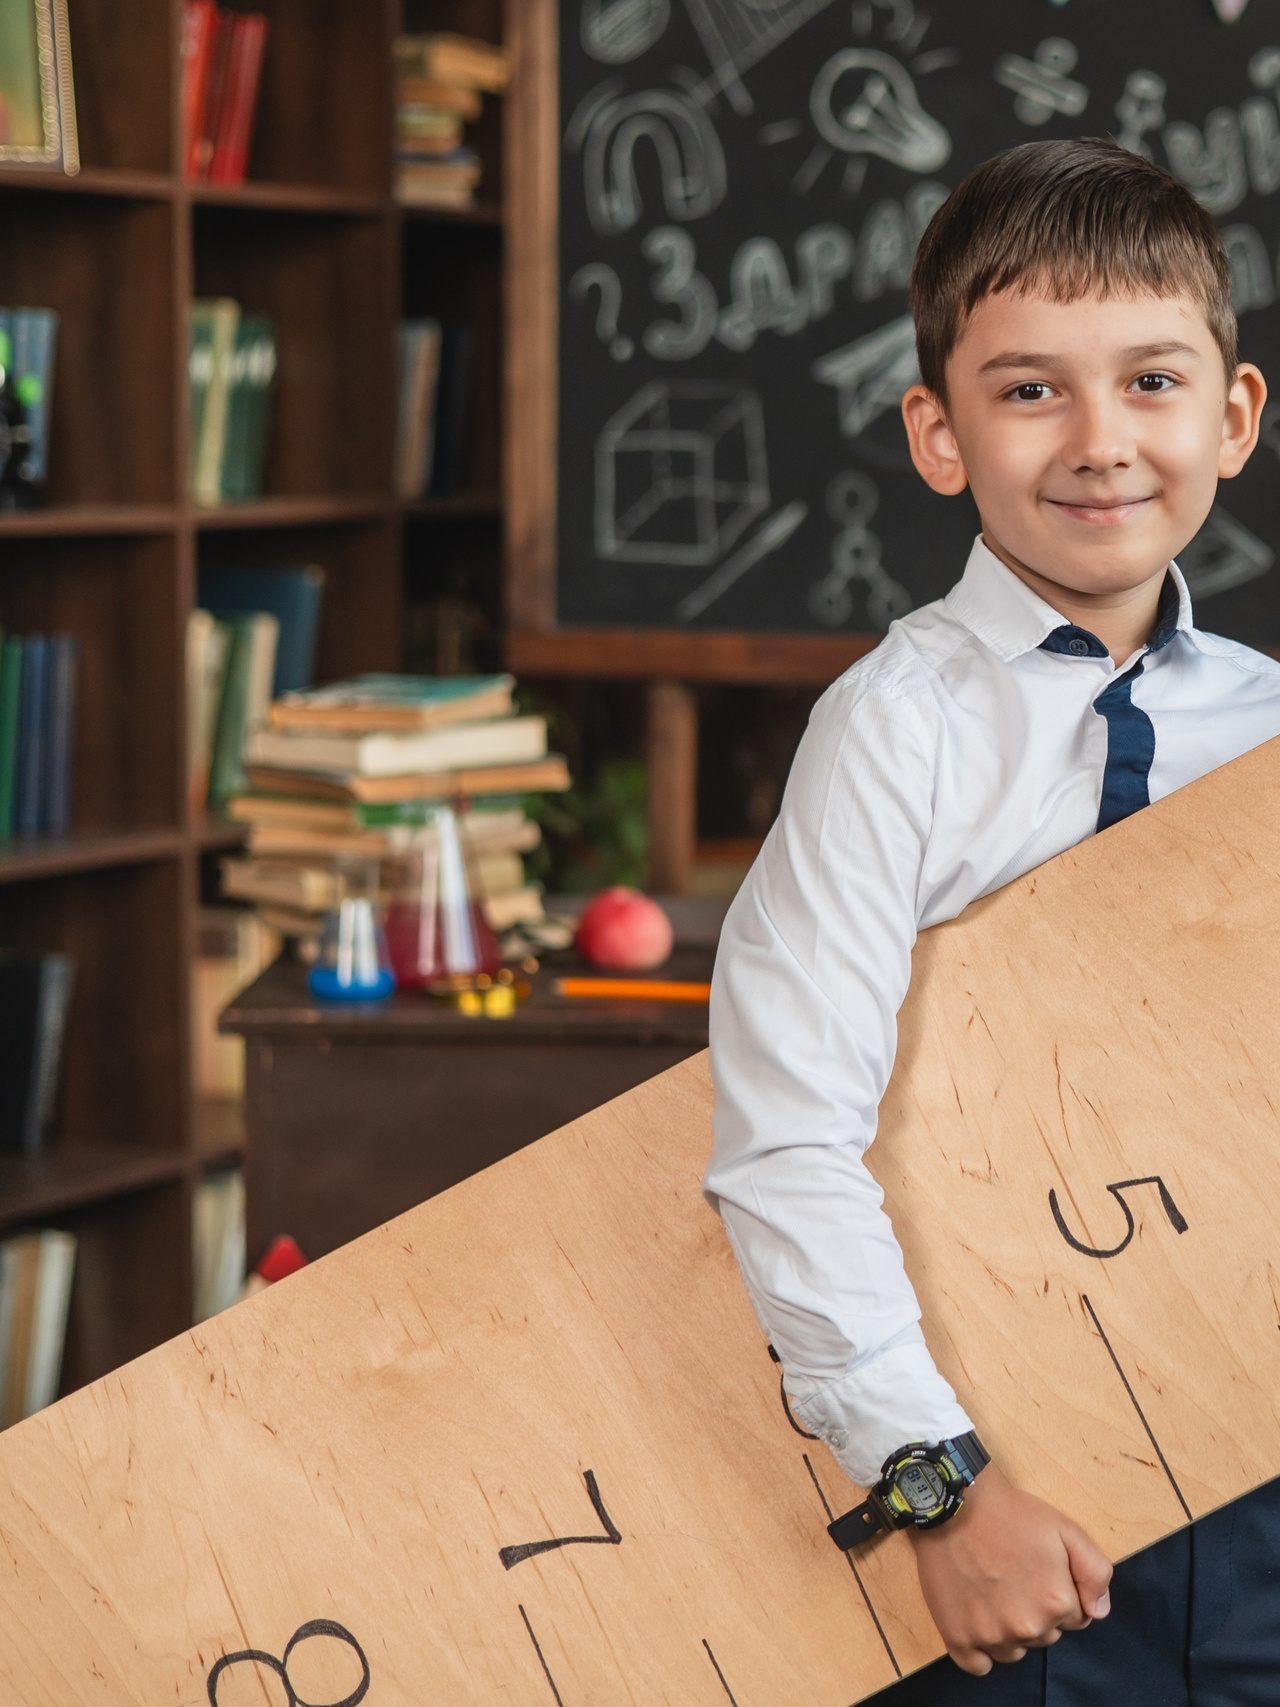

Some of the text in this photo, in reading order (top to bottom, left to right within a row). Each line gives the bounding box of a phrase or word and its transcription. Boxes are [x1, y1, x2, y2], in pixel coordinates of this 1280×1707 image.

[1047, 1175, 1190, 1260] 5
[498, 1468, 623, 1572] 7
[882, 1495, 899, 1519] SPORT
[206, 1618, 371, 1707] 8
